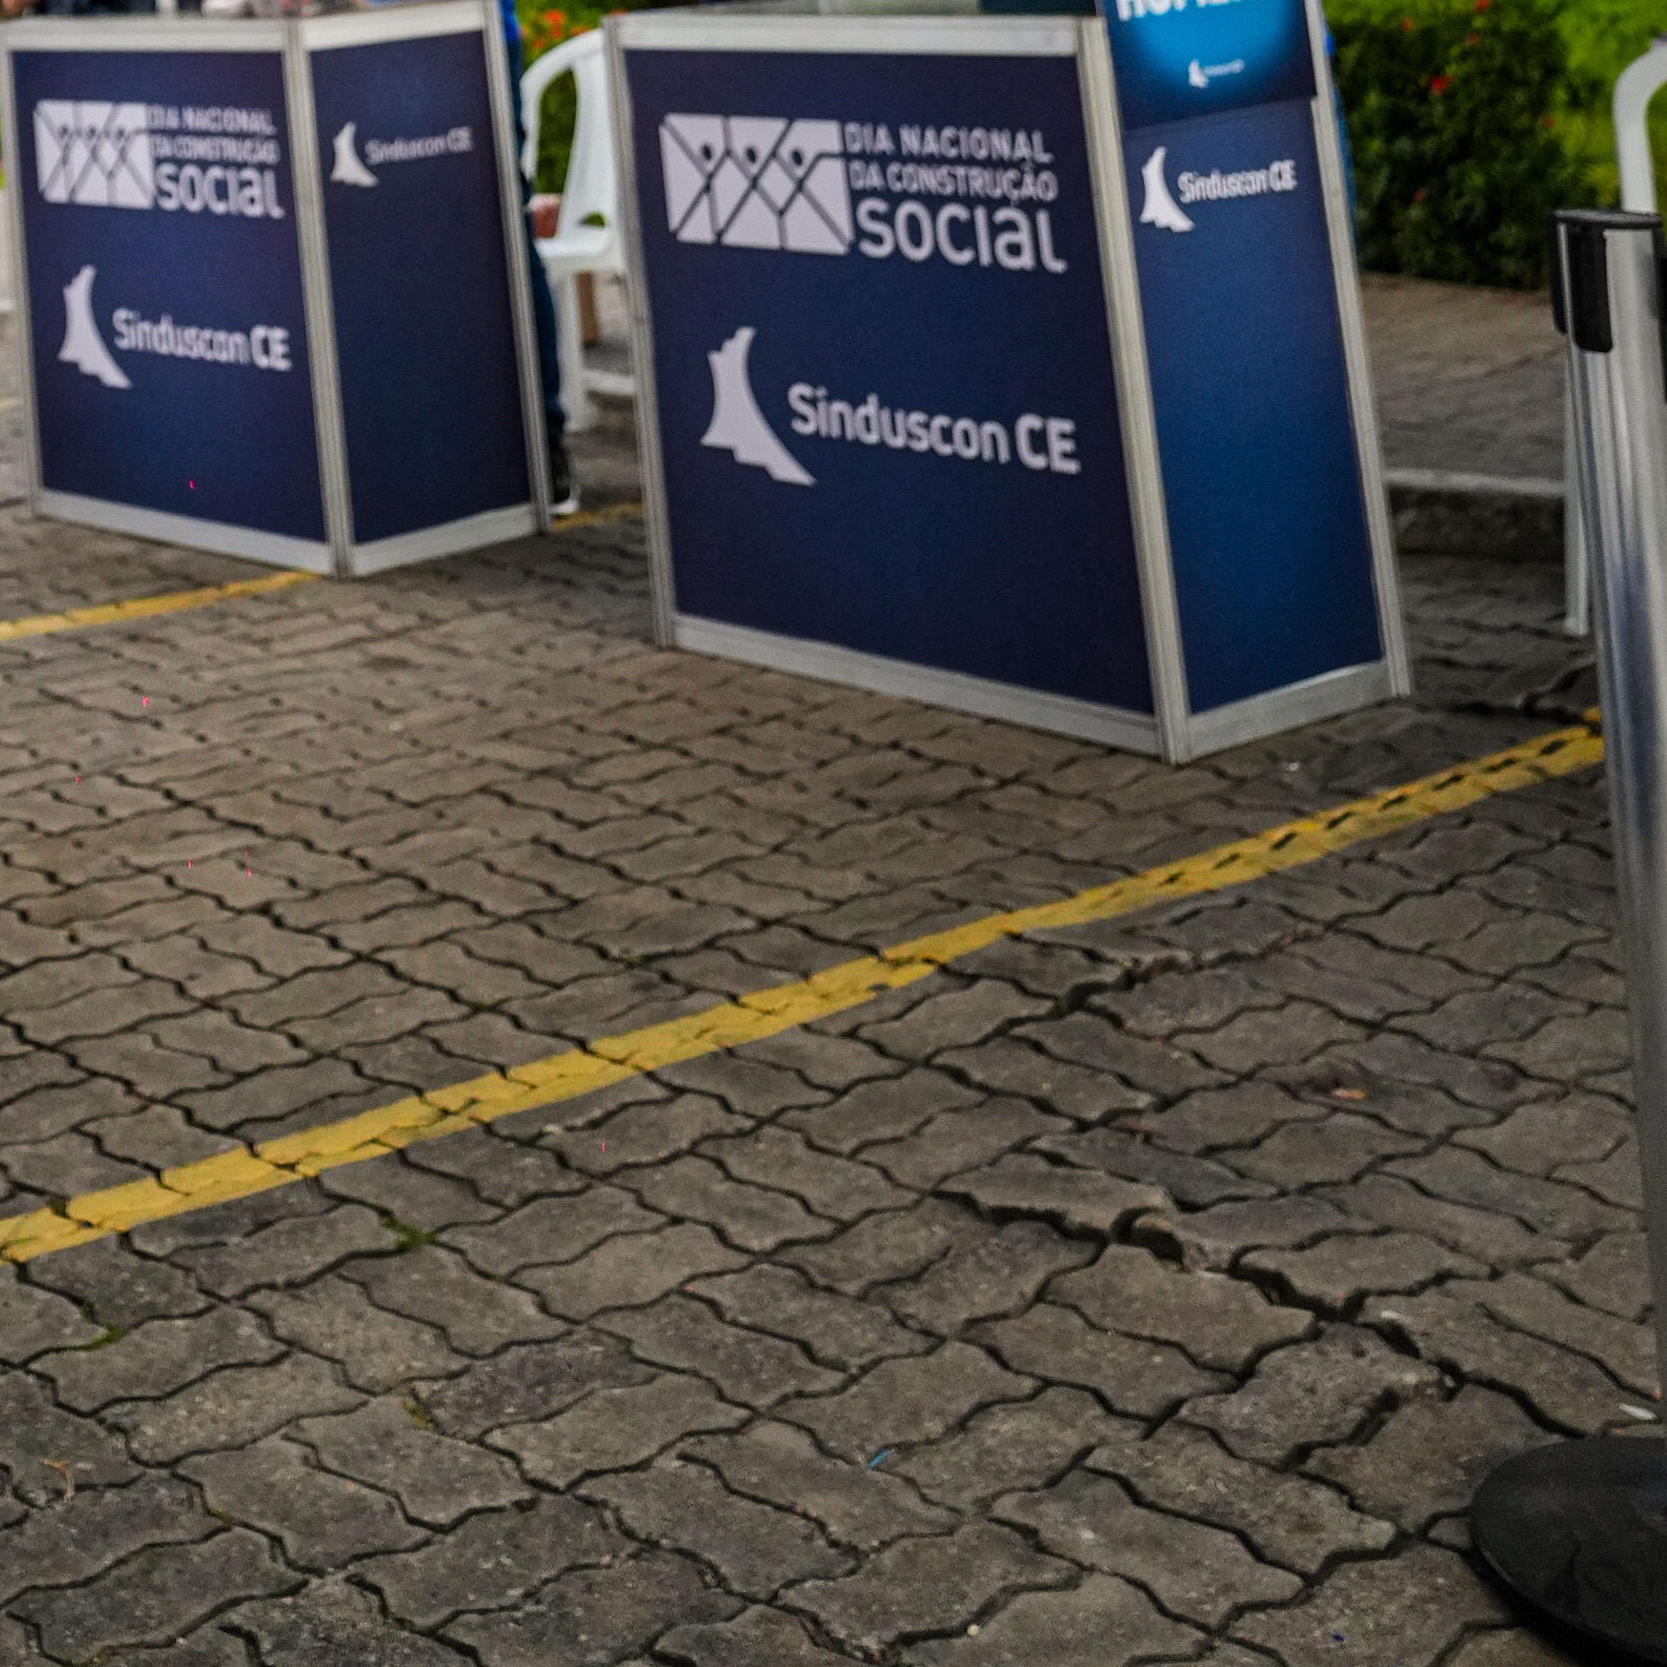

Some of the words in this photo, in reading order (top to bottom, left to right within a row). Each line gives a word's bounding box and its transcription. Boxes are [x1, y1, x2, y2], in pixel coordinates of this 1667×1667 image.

[844, 120, 895, 155] DIA
[900, 124, 1054, 165] NACIONAL
[848, 160, 885, 192] DA
[887, 163, 1059, 206] CONSTRUÇÃO
[1176, 169, 1268, 204] Sinduscon
[1268, 160, 1298, 192] CE
[111, 307, 251, 365] Sinduscon
[251, 324, 292, 371] CE
[787, 381, 1011, 464] Sinduscon
[1015, 412, 1082, 475] CE
